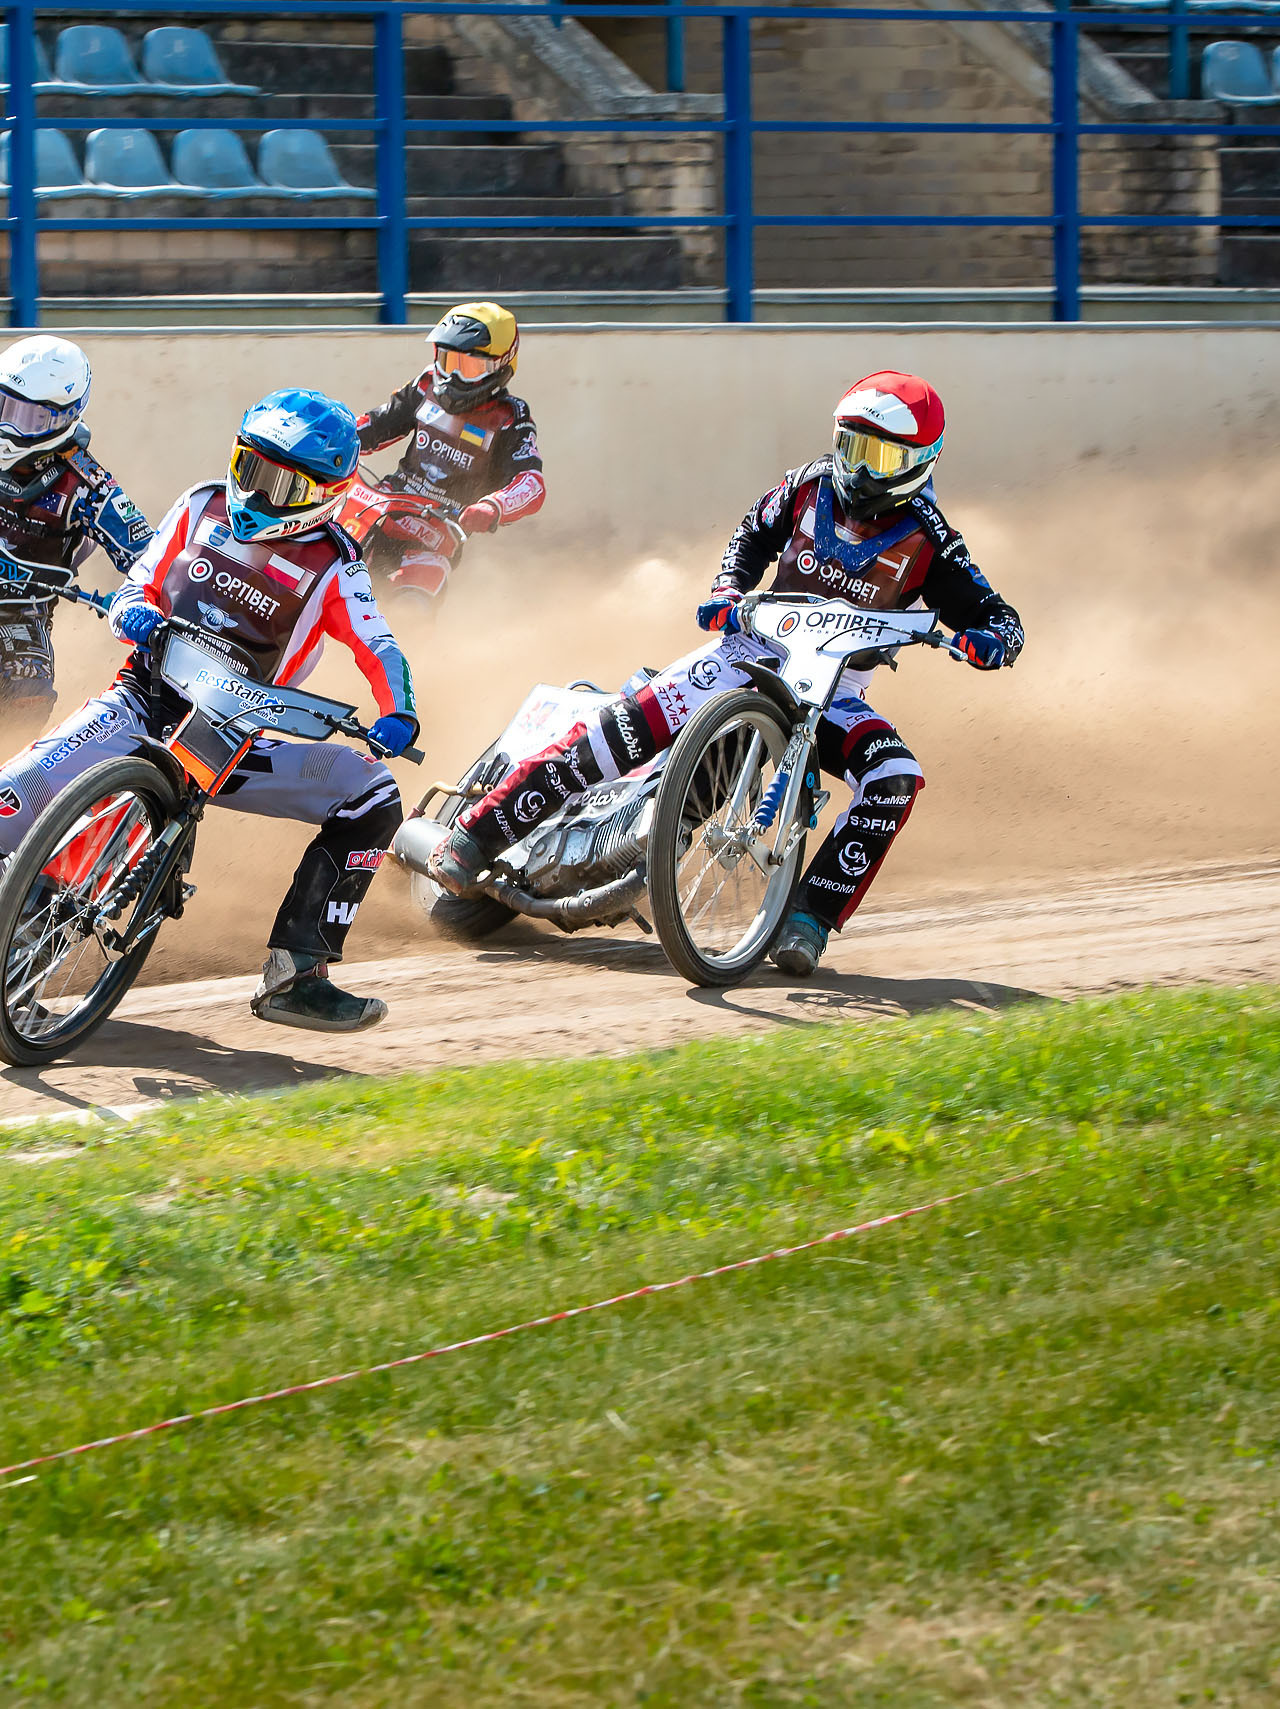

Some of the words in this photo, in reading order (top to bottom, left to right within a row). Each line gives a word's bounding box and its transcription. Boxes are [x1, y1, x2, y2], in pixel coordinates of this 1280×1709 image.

[431, 439, 475, 468] OPTIBET
[911, 497, 948, 543] SOFIA
[215, 571, 281, 617] OPTIBET
[820, 564, 881, 600] OPTIBET
[805, 611, 889, 637] OPTIBET
[195, 670, 269, 705] BestStaff
[39, 718, 104, 770] BestStaff
[849, 815, 897, 832] SOFIA
[808, 875, 857, 895] ALPROMA
